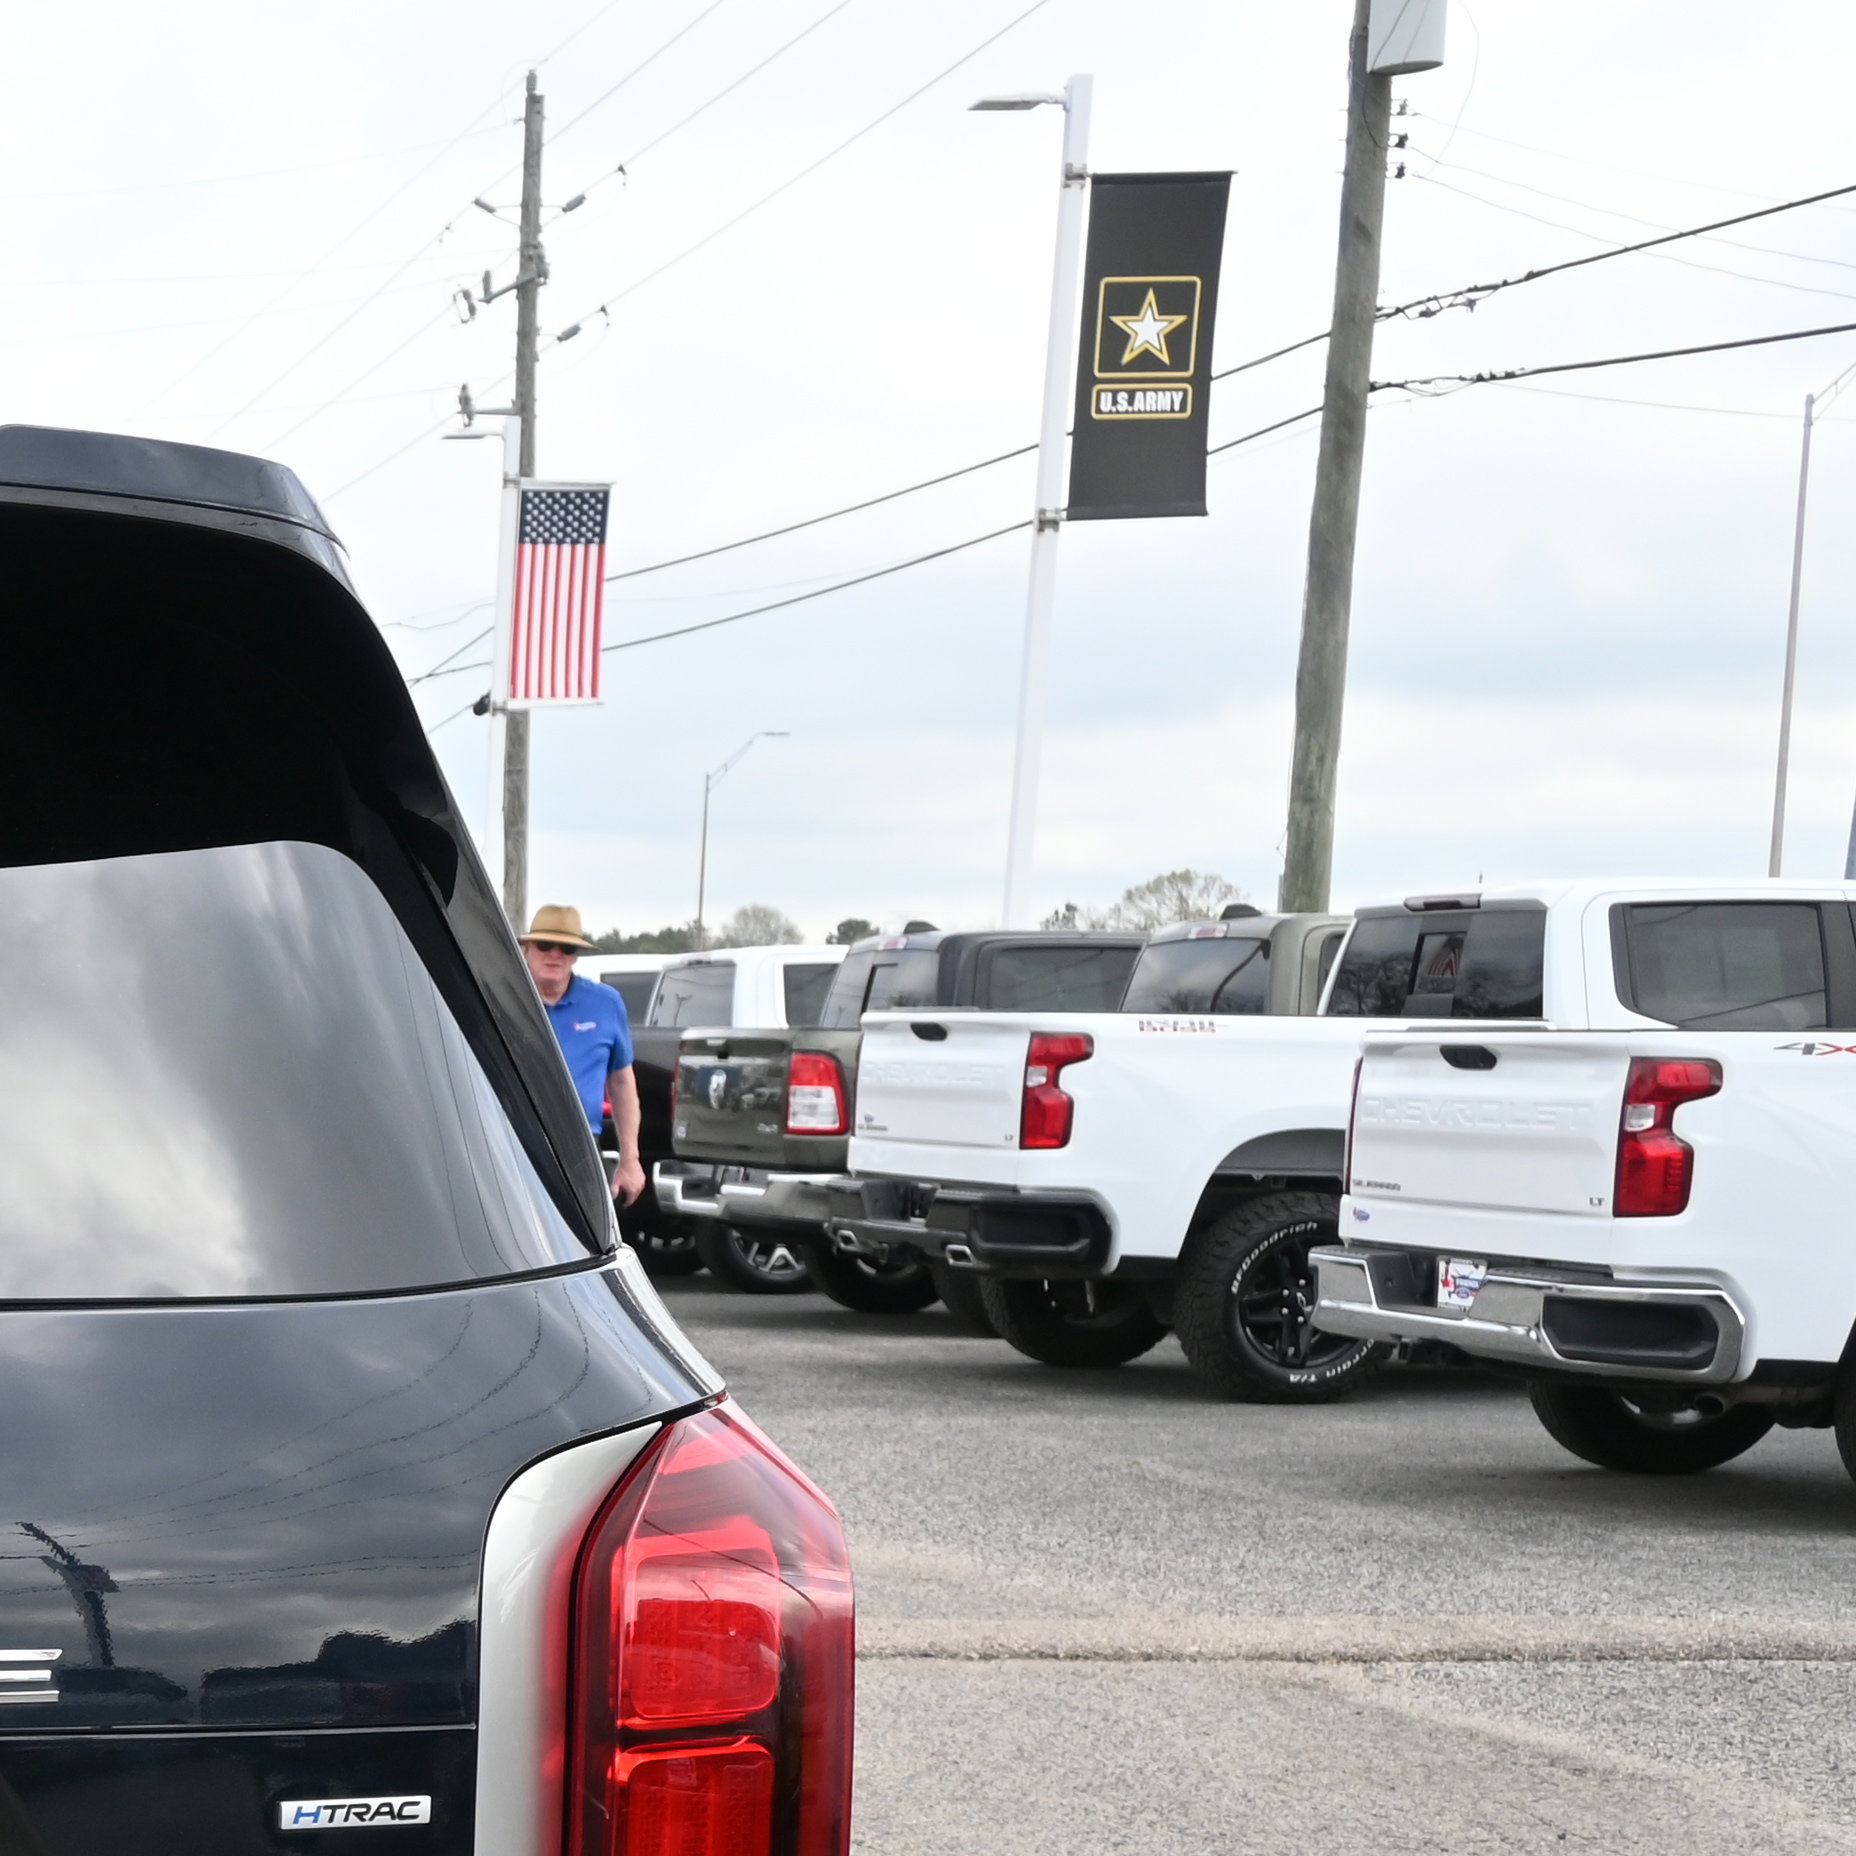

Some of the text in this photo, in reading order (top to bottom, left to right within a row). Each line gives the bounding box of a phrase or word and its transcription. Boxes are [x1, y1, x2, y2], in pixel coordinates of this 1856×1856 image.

[1773, 1042, 1856, 1056] 4X
[1589, 1197, 1605, 1207] LT
[1326, 1338, 1375, 1378] errain
[292, 1801, 421, 1825] HTRAC
